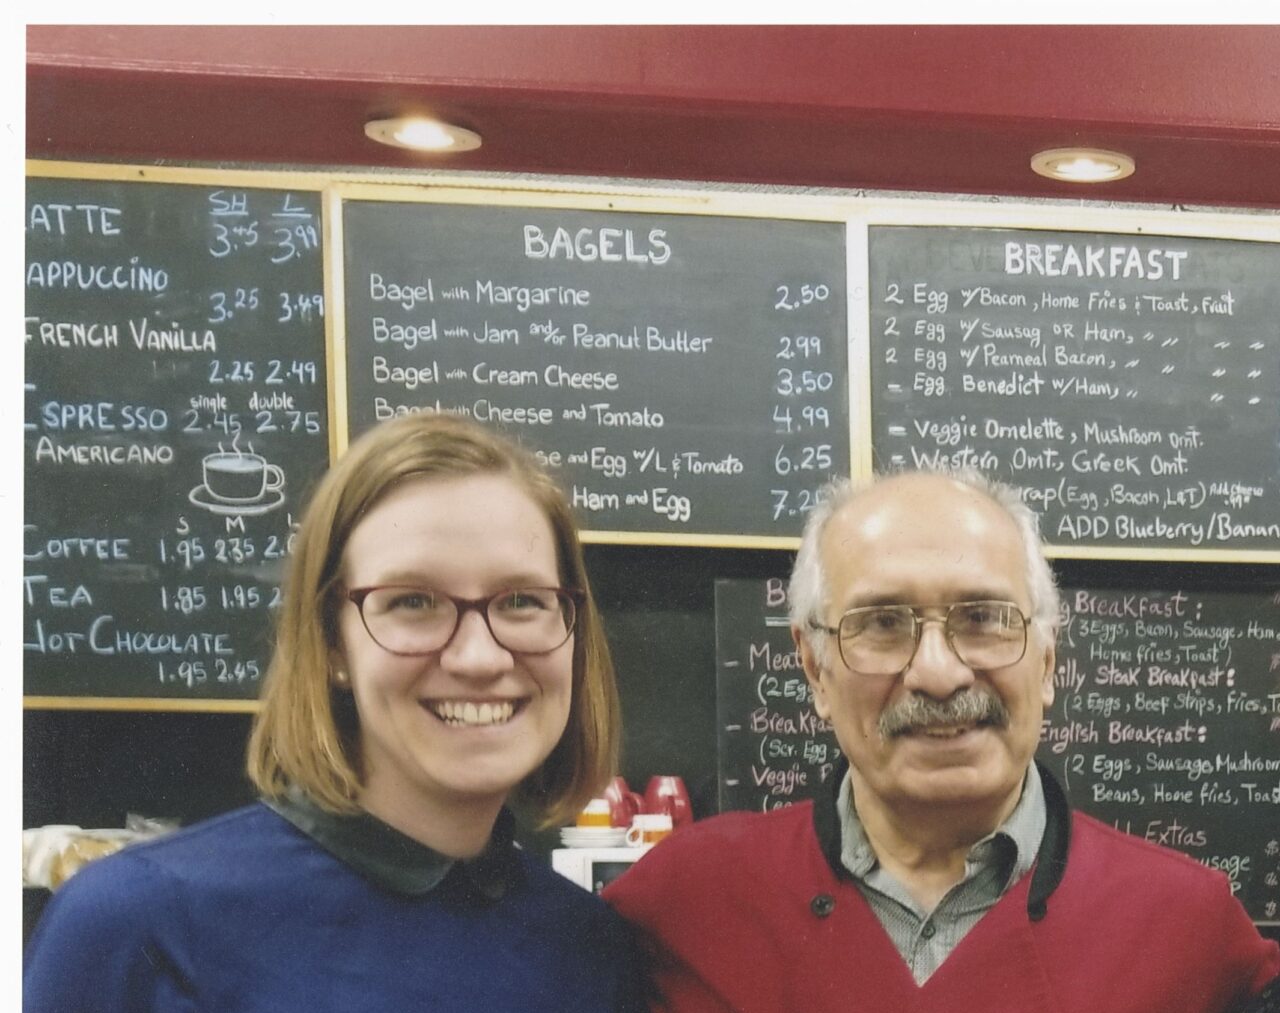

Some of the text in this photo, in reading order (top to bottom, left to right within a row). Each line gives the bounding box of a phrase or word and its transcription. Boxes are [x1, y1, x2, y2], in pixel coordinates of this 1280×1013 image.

[208, 190, 249, 216] SH
[271, 225, 318, 263] 3.99
[523, 225, 671, 265] BAGELS
[1004, 242, 1188, 280] BREAKFAST
[208, 288, 259, 323] 3.25
[370, 273, 830, 312] Bagel with Margarine 2.50
[884, 283, 904, 304] 2
[913, 283, 949, 314] Egg
[1041, 292, 1080, 310] Home
[372, 317, 437, 350] Bagel
[473, 320, 519, 345] Jam
[572, 323, 641, 350] Peanut
[646, 326, 713, 354] Butter
[776, 335, 822, 359] 2.99
[884, 316, 900, 336] 2
[914, 319, 945, 343] Egg
[209, 360, 316, 384] 2.25 2.49
[886, 347, 898, 364] 2
[914, 347, 947, 372] Egg
[1055, 345, 1117, 370] Bacon,
[372, 356, 439, 390] Bagel
[472, 361, 538, 386] Cream
[544, 365, 619, 390] Cheese
[777, 368, 833, 395] 3.50
[913, 371, 945, 396] Egg
[962, 371, 1044, 396] Benedict
[190, 392, 295, 412] single double
[473, 399, 830, 433] Cheese and Tomato 4.99
[183, 410, 320, 435] 2.45 2.75
[913, 415, 978, 446] Veggie
[1084, 422, 1162, 445] Mushroom
[36, 436, 173, 464] AMERICANO
[567, 450, 588, 464] and
[590, 447, 627, 477] Egg
[681, 452, 744, 474] Tomato
[775, 444, 832, 475] 6.25
[1071, 449, 1141, 475] Greek
[572, 485, 691, 522] Ham and Egg
[176, 515, 246, 535] S M
[1057, 514, 1109, 540] ADD
[159, 538, 205, 570] 1.95
[24, 575, 93, 606] TEA
[221, 585, 260, 610] 1.95
[90, 615, 235, 655] CHOCOLATE
[159, 658, 260, 687] 1.95 2.45
[752, 761, 807, 795] Veggie
[1153, 782, 1193, 804] Home
[1144, 819, 1207, 847] Extras
